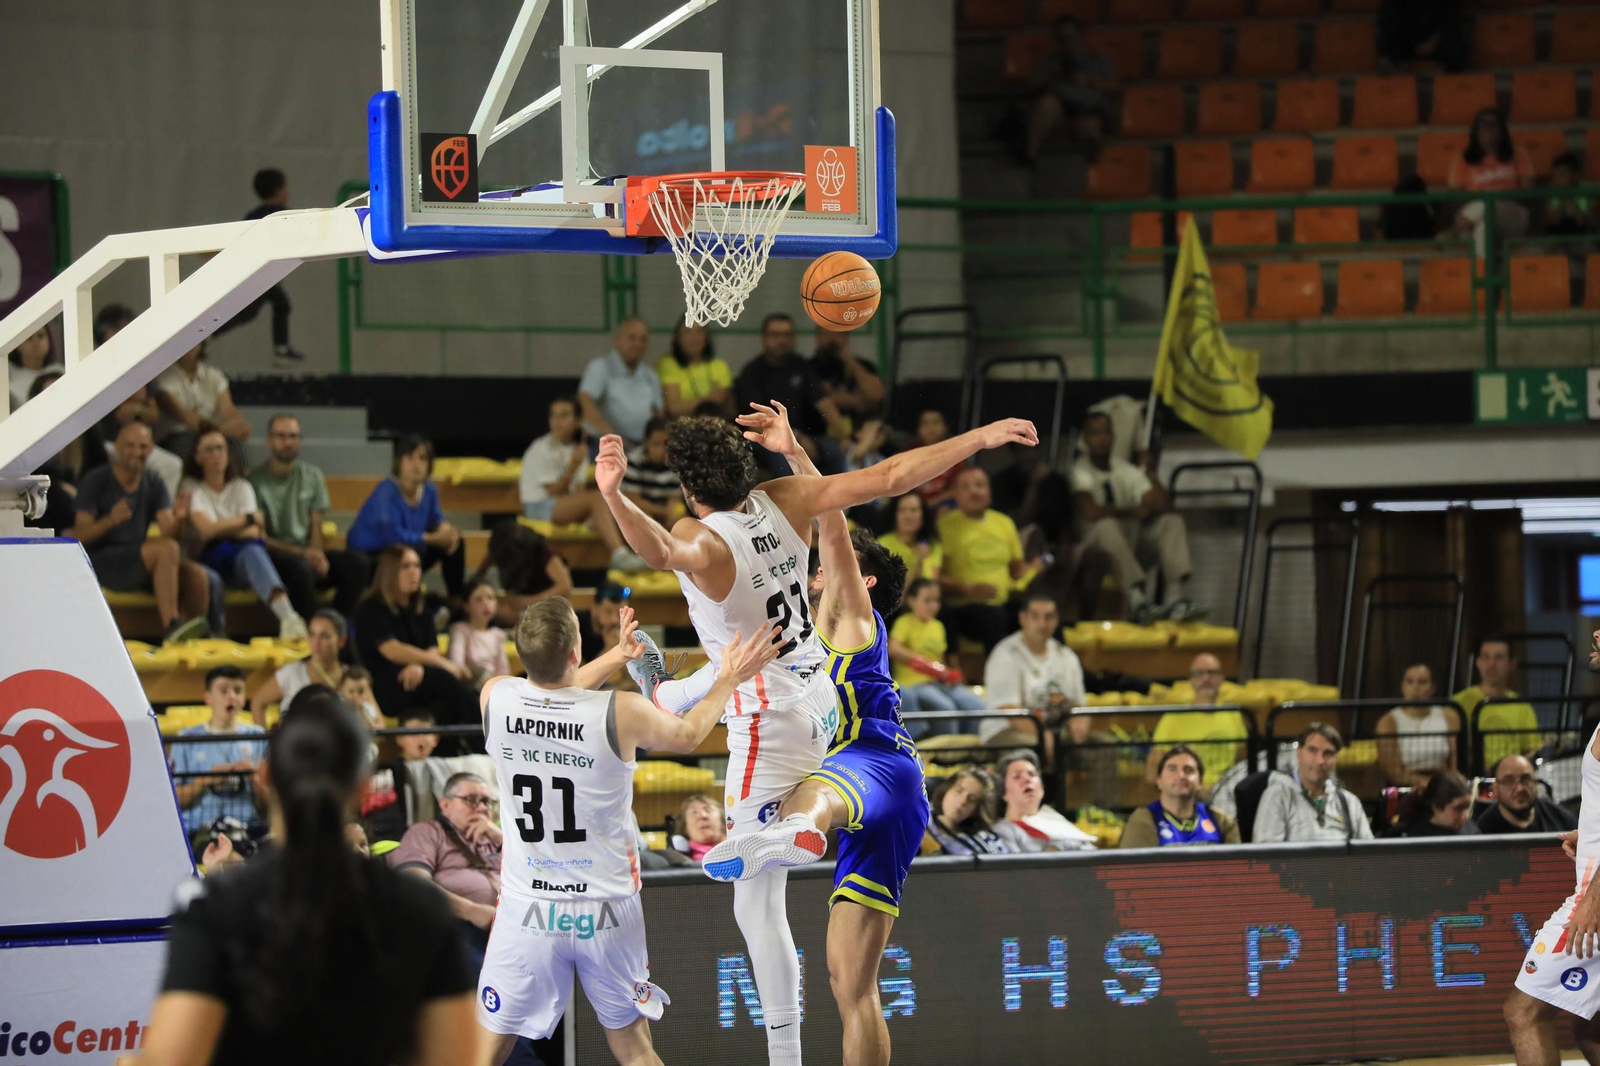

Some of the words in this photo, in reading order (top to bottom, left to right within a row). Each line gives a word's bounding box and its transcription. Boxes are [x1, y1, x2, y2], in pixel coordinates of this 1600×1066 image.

[821, 203, 841, 212] FEB
[829, 277, 880, 298] Wilson
[505, 715, 585, 742] LAPORNIK
[521, 748, 540, 763] RIC
[544, 751, 595, 769] ENERGY
[512, 773, 587, 844] 31
[544, 930, 572, 938] derecho
[1001, 930, 1163, 1012] HS
